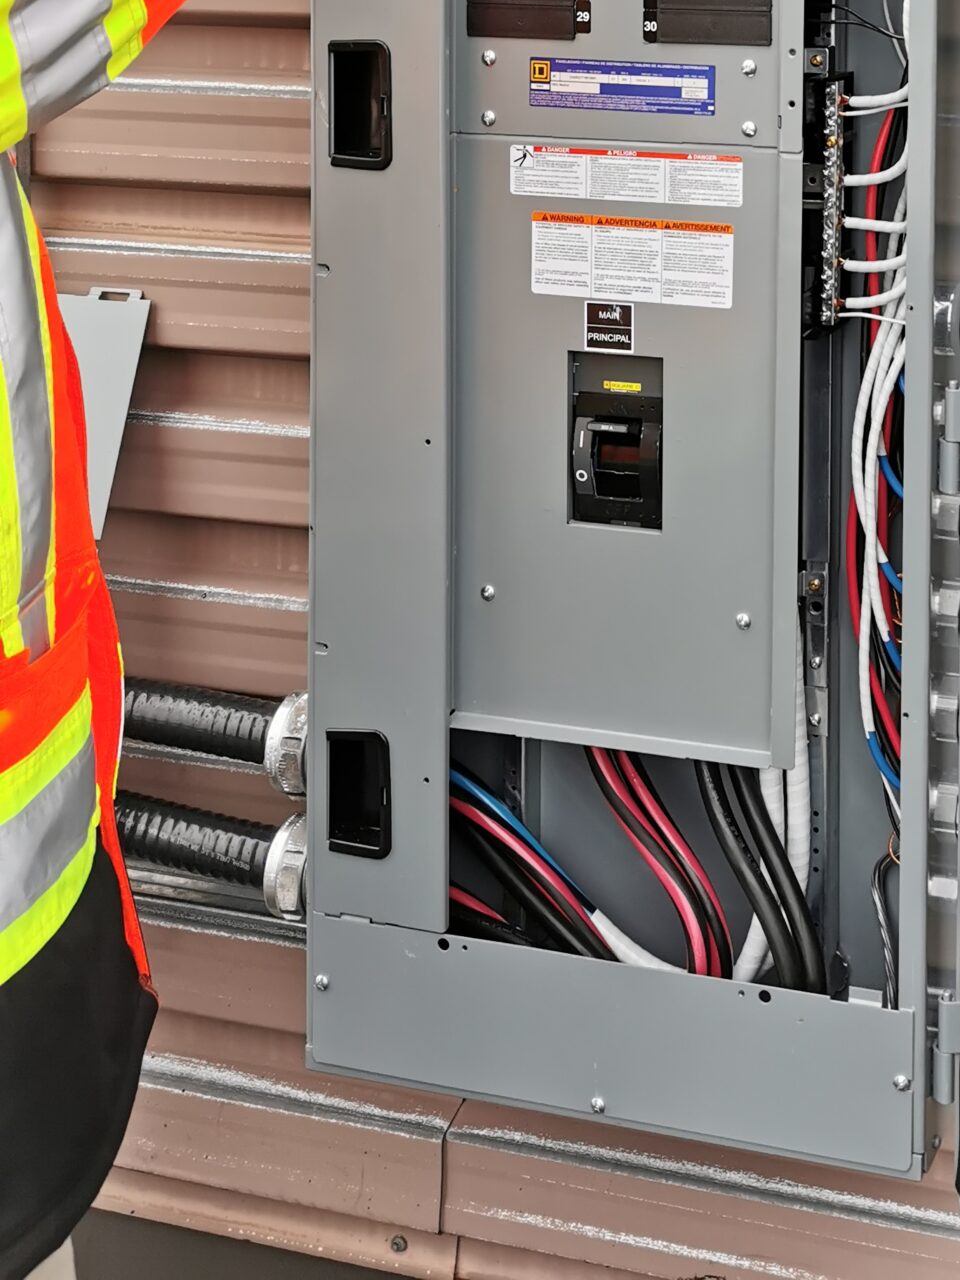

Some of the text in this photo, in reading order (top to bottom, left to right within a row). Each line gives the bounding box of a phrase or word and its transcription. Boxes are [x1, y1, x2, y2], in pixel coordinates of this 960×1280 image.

[577, 11, 589, 23] 29
[643, 21, 657, 33] 30
[533, 63, 548, 79] D
[612, 149, 637, 157] PELIGRO
[549, 213, 585, 224] WARNING
[604, 217, 658, 228] ADVERTENCIA
[671, 222, 731, 233] AVERTISSEMENT
[598, 310, 620, 321] MAIN
[587, 332, 631, 343] PRINCIPAL
